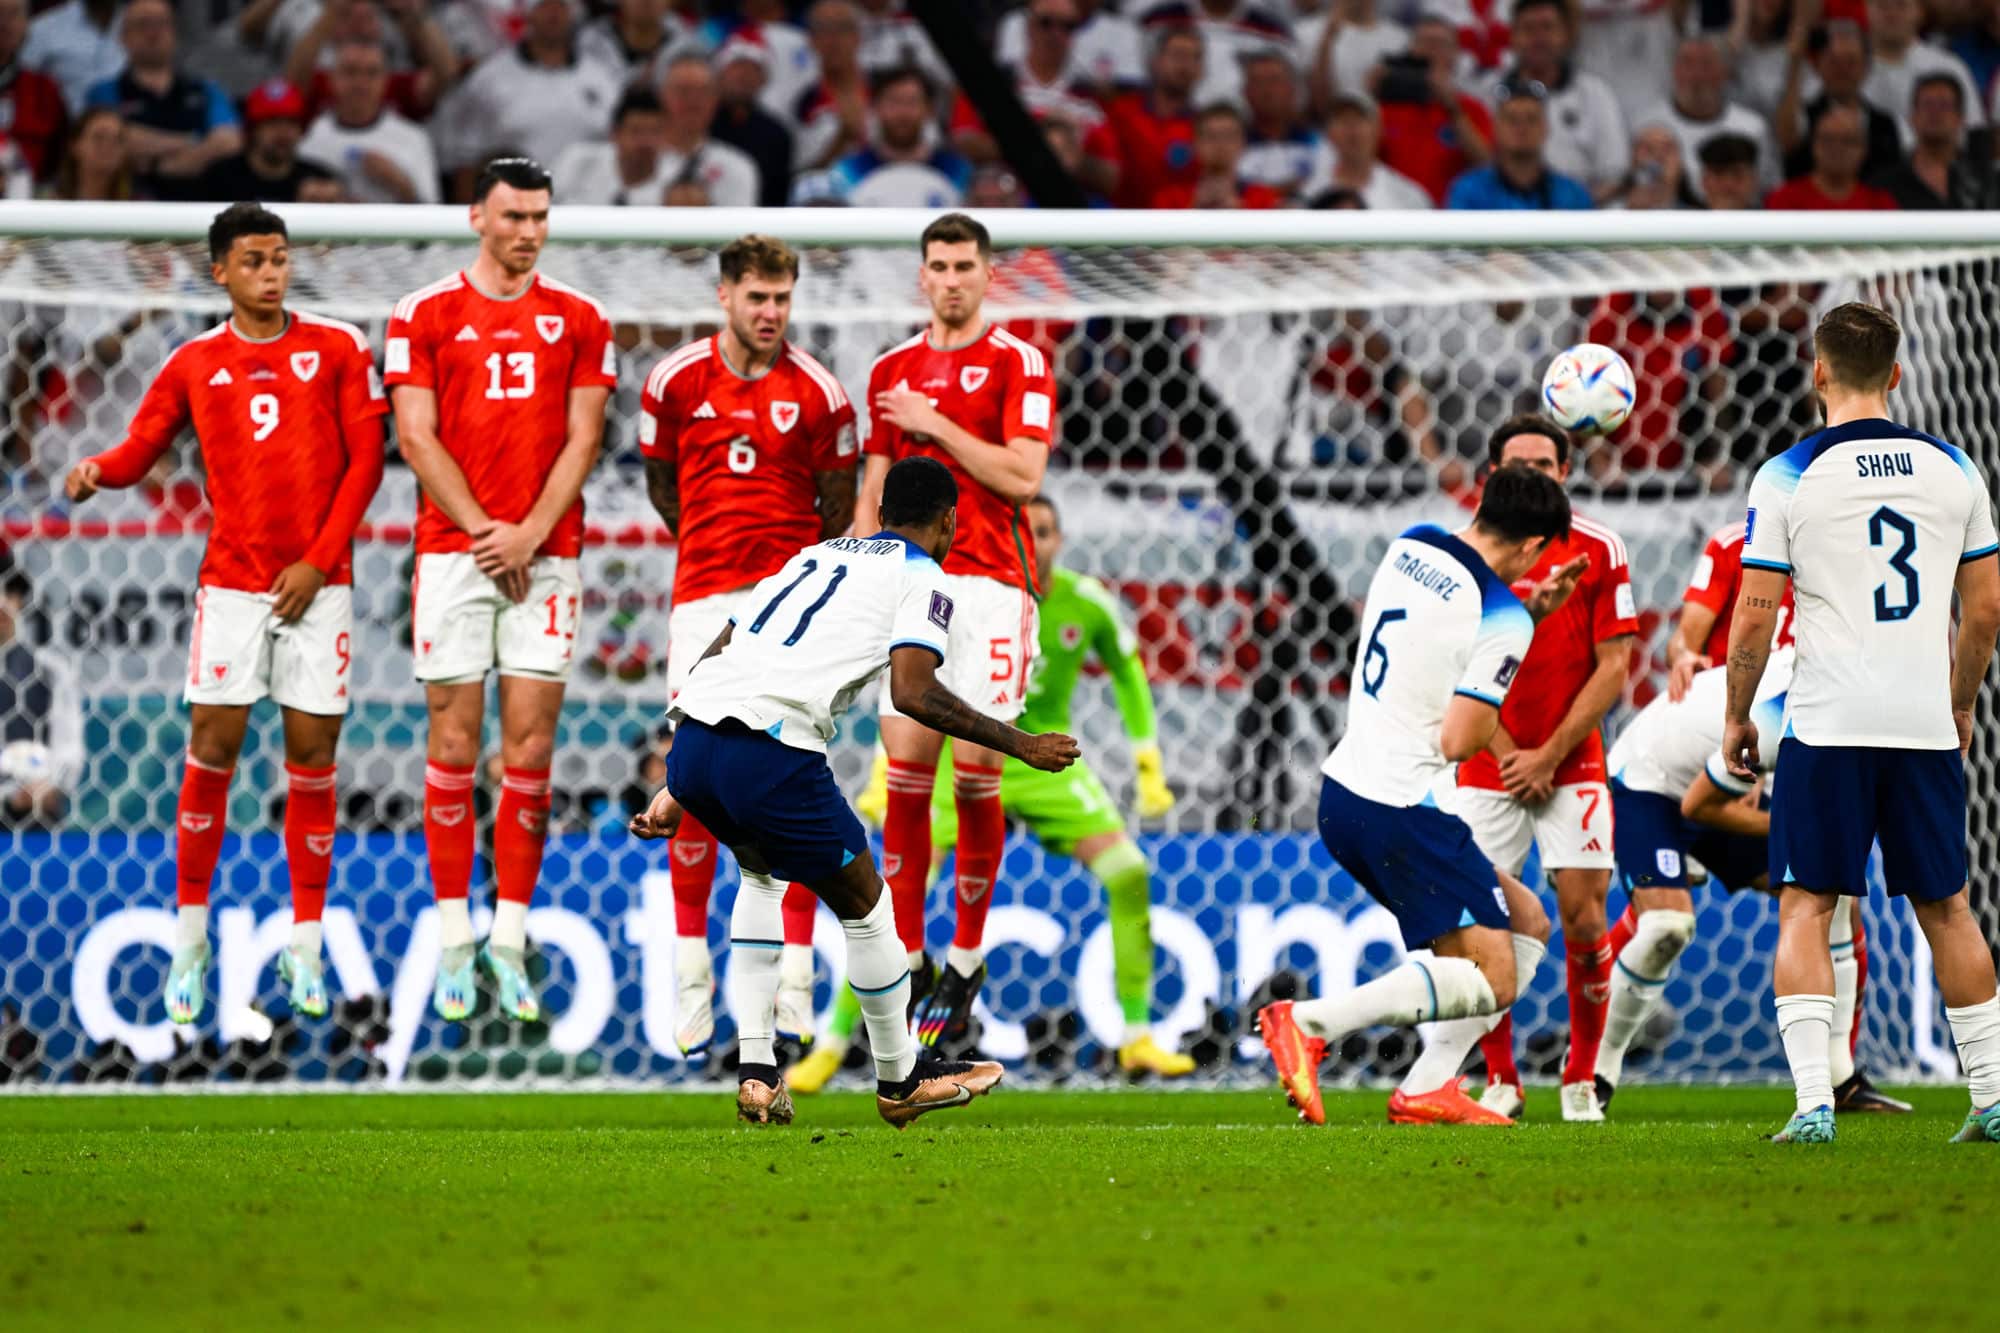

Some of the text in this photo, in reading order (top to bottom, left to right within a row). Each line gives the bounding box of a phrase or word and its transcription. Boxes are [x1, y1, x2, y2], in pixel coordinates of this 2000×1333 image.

[485, 352, 535, 399] 13
[249, 393, 280, 441] 9
[727, 434, 757, 474] 6
[1855, 452, 1914, 478] SHAW
[1393, 551, 1462, 602] MAGUIRE
[1868, 505, 1920, 622] 3
[748, 558, 847, 647] 11
[336, 631, 351, 676] 9
[989, 637, 1014, 682] 5
[1362, 607, 1407, 702] 6
[1575, 787, 1601, 832] 7
[71, 867, 1437, 1083] cryptcom
